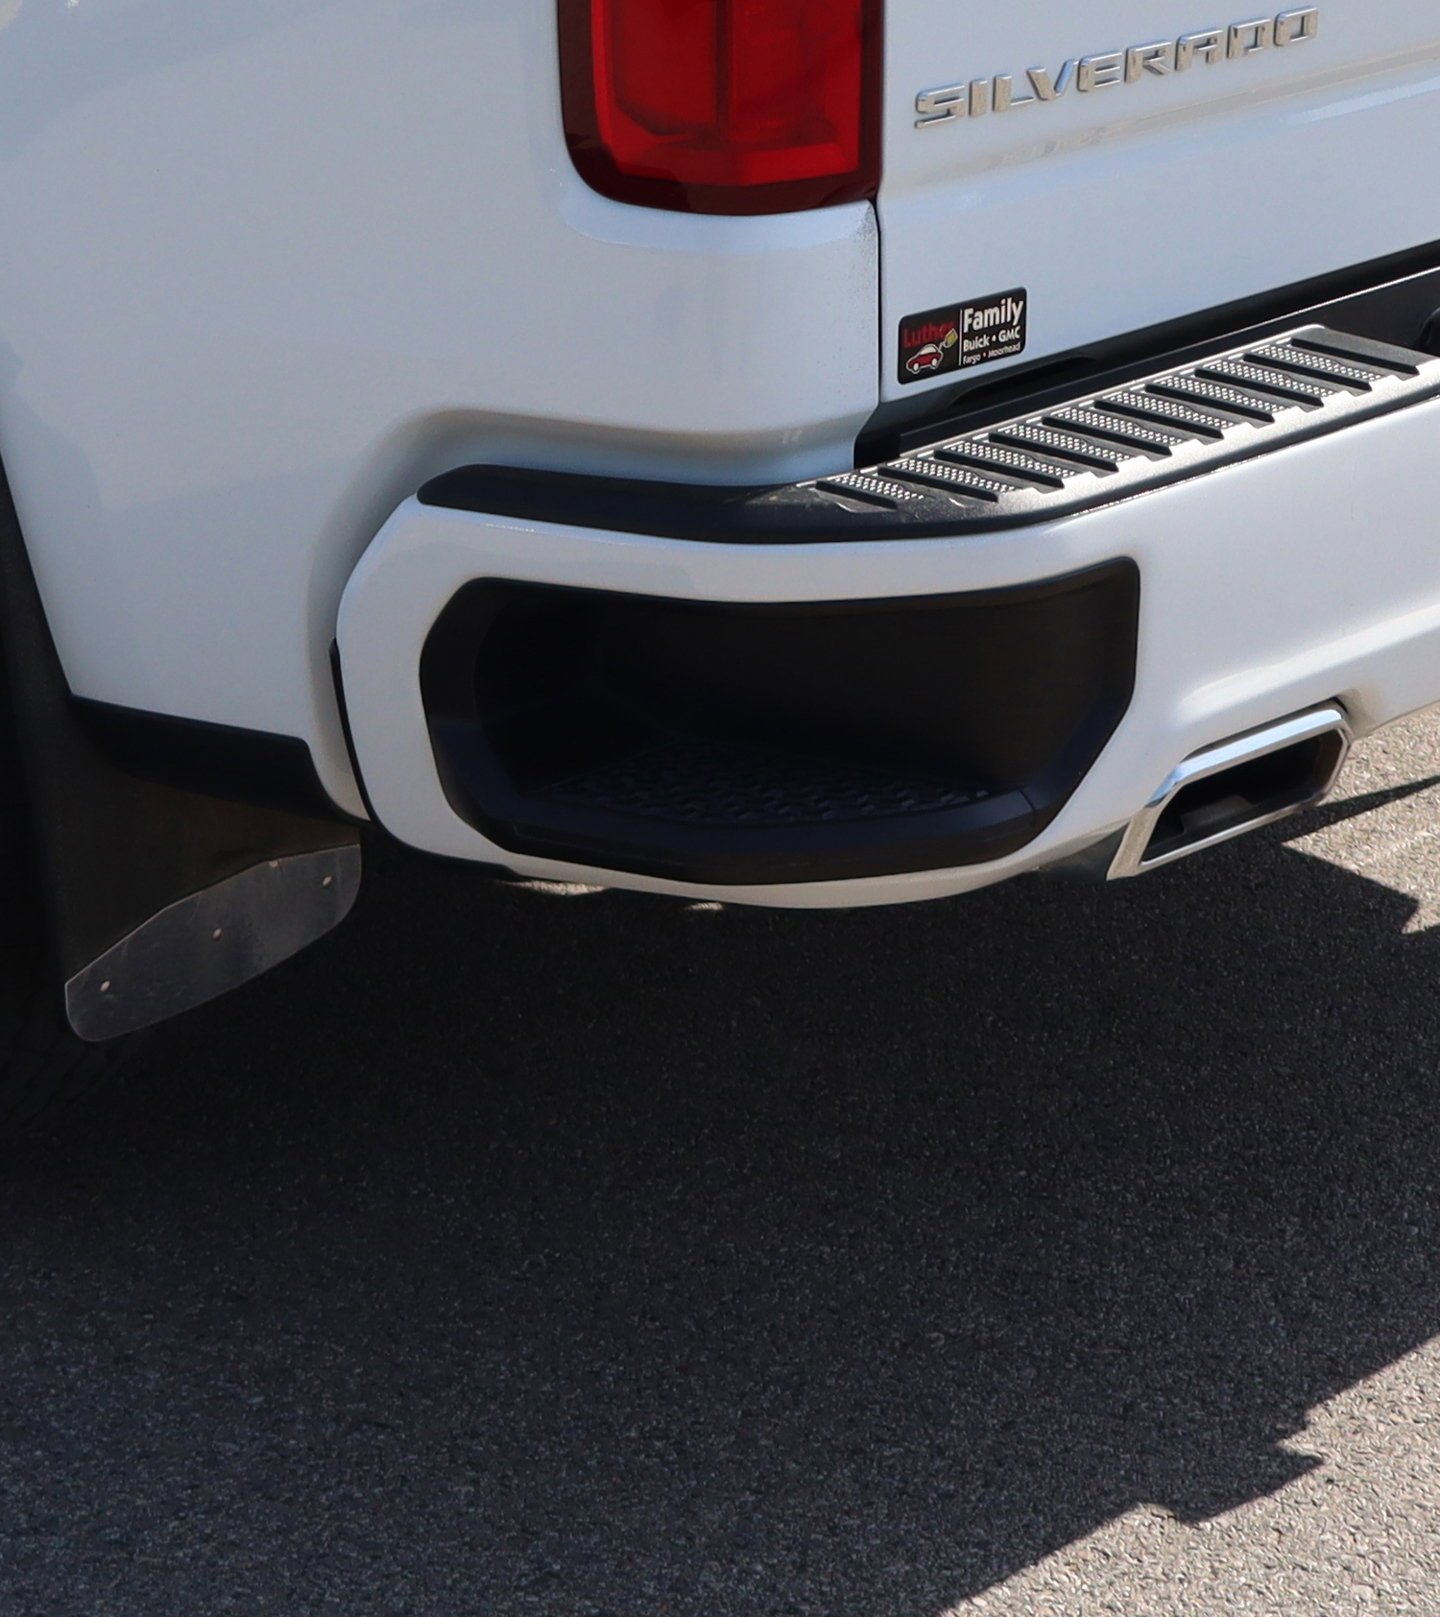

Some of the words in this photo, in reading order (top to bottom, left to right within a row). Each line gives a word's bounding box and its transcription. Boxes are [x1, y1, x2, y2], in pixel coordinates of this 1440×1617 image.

[914, 5, 1319, 129] SILVERADO
[963, 297, 1024, 334] Family
[963, 334, 990, 352] Buick
[998, 325, 1021, 343] GMC
[963, 351, 982, 365] Fargo
[987, 341, 1021, 359] Moorhead
